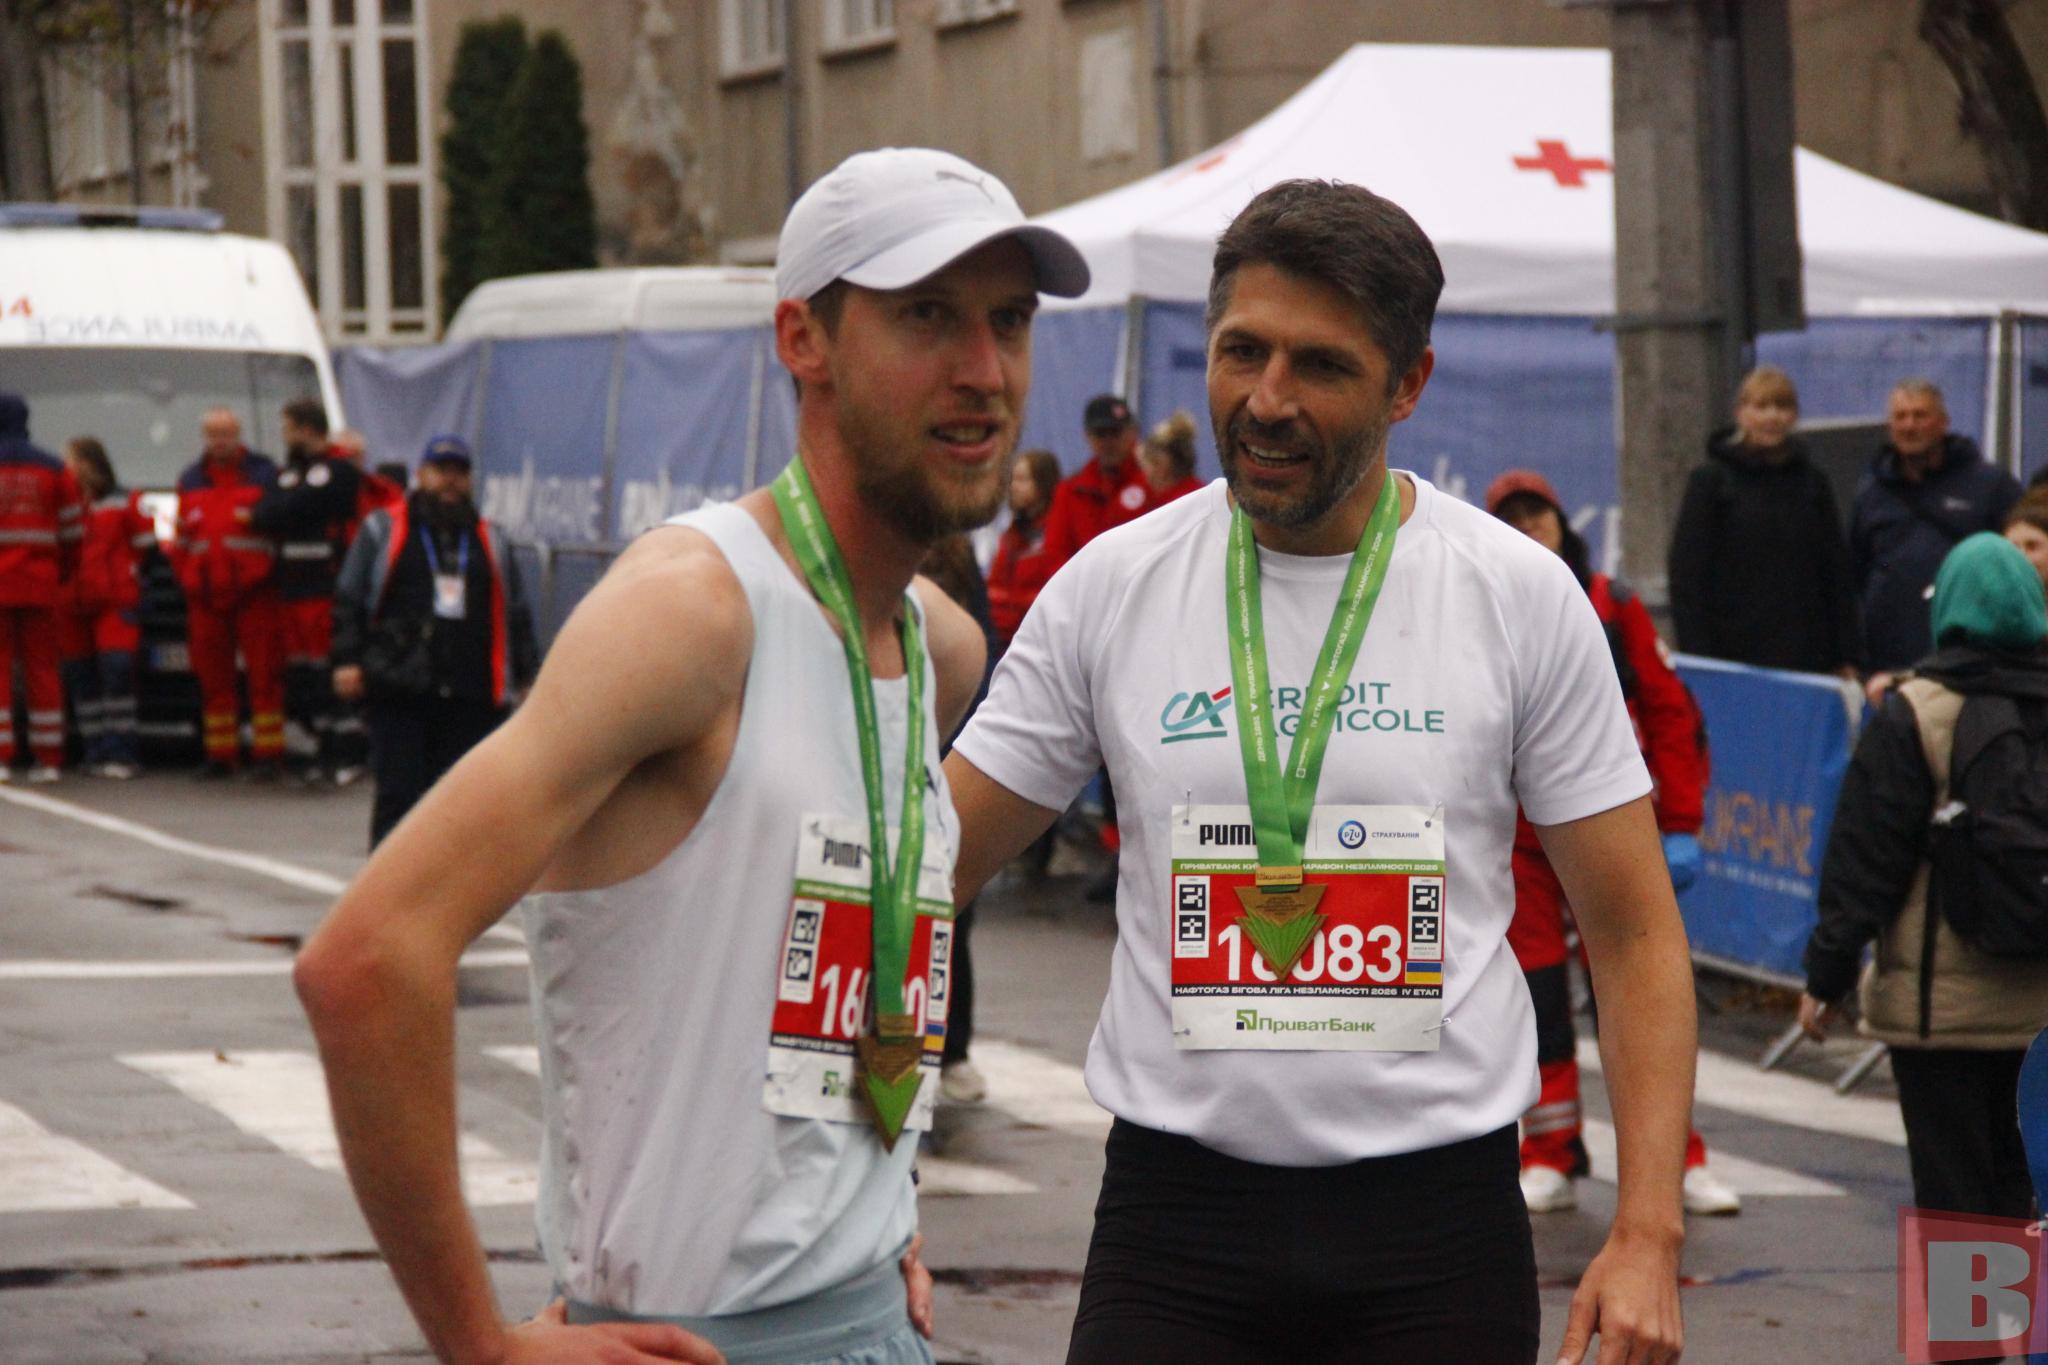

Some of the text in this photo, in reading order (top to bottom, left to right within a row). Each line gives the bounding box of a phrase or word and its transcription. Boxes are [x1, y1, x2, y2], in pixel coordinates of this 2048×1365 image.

[1269, 682, 1391, 710] RDIT
[1274, 709, 1445, 737] GICOLE
[1199, 824, 1257, 846] PUM
[1371, 831, 1420, 839] СТРАХУВАННЯ
[1175, 987, 1230, 995] НАФТОГАЗ
[1231, 987, 1267, 995] БІГОВА
[1269, 987, 1292, 995] ЛІГА
[1293, 987, 1369, 996] НЕЗЛАМНОСТІ
[1371, 988, 1398, 996] 2026
[1413, 989, 1440, 997] ЕТАП
[1259, 1017, 1376, 1034] ПриватБанк
